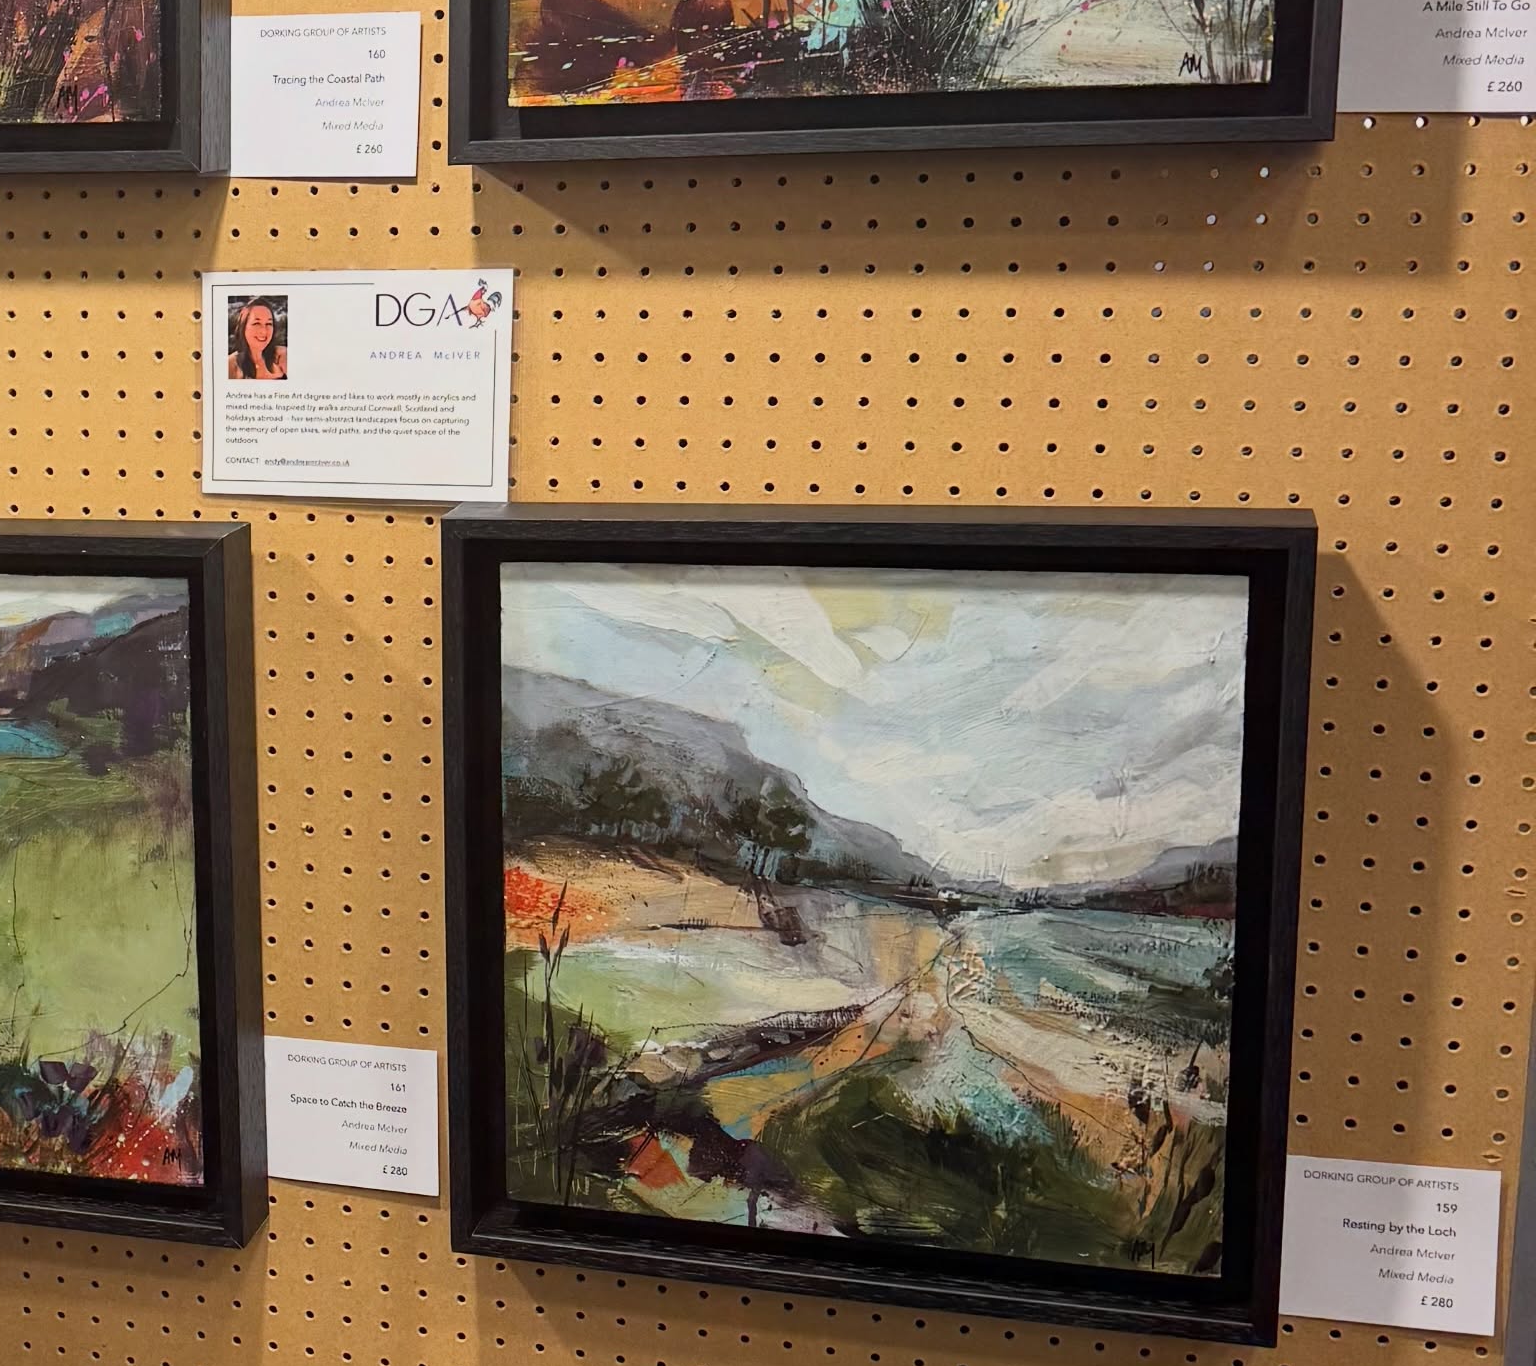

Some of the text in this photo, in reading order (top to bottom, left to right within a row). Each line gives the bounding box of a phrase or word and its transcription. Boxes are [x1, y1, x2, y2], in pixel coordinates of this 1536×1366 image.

[1423, 0, 1530, 11] A Mile Still To Go
[260, 27, 386, 38] DORKING GROUP OF ARTISTS
[1435, 28, 1527, 39] Andrea McIver
[368, 50, 385, 59] 160
[1443, 55, 1524, 66] Mixed Media
[273, 73, 385, 86] Tracing the Coastal Path
[1498, 81, 1522, 92] 260
[315, 98, 384, 107] Andrea McIver
[322, 121, 383, 130] Mixed Media
[364, 144, 382, 154] 260
[375, 292, 463, 327] DGA
[370, 351, 480, 360] ANDREA McIVER
[304, 393, 330, 401] degree
[397, 394, 420, 402] mostly
[432, 394, 459, 403] acrylics
[276, 404, 305, 412] Inspired
[307, 404, 316, 412] by
[225, 415, 255, 423] holidays
[356, 416, 397, 424] landscapes
[433, 417, 469, 426] capturing
[288, 1054, 326, 1065] DORKING
[329, 1057, 358, 1067] GROUP
[374, 1063, 406, 1072] ARTISTS
[391, 1083, 406, 1092] 161
[290, 1094, 407, 1113] Space to Catch the Breeze
[342, 1120, 407, 1134] Andrea McIver
[350, 1141, 407, 1155] Mixed Media
[390, 1166, 407, 1176] 280
[1304, 1169, 1459, 1191] DORKING GROUP OF ARTISTS
[1436, 1203, 1457, 1214] 159
[1343, 1218, 1456, 1238] Resting by the Loch
[1370, 1244, 1454, 1260] Andrea McIver
[1379, 1268, 1454, 1284] Mixed Media
[1431, 1296, 1453, 1308] 280
